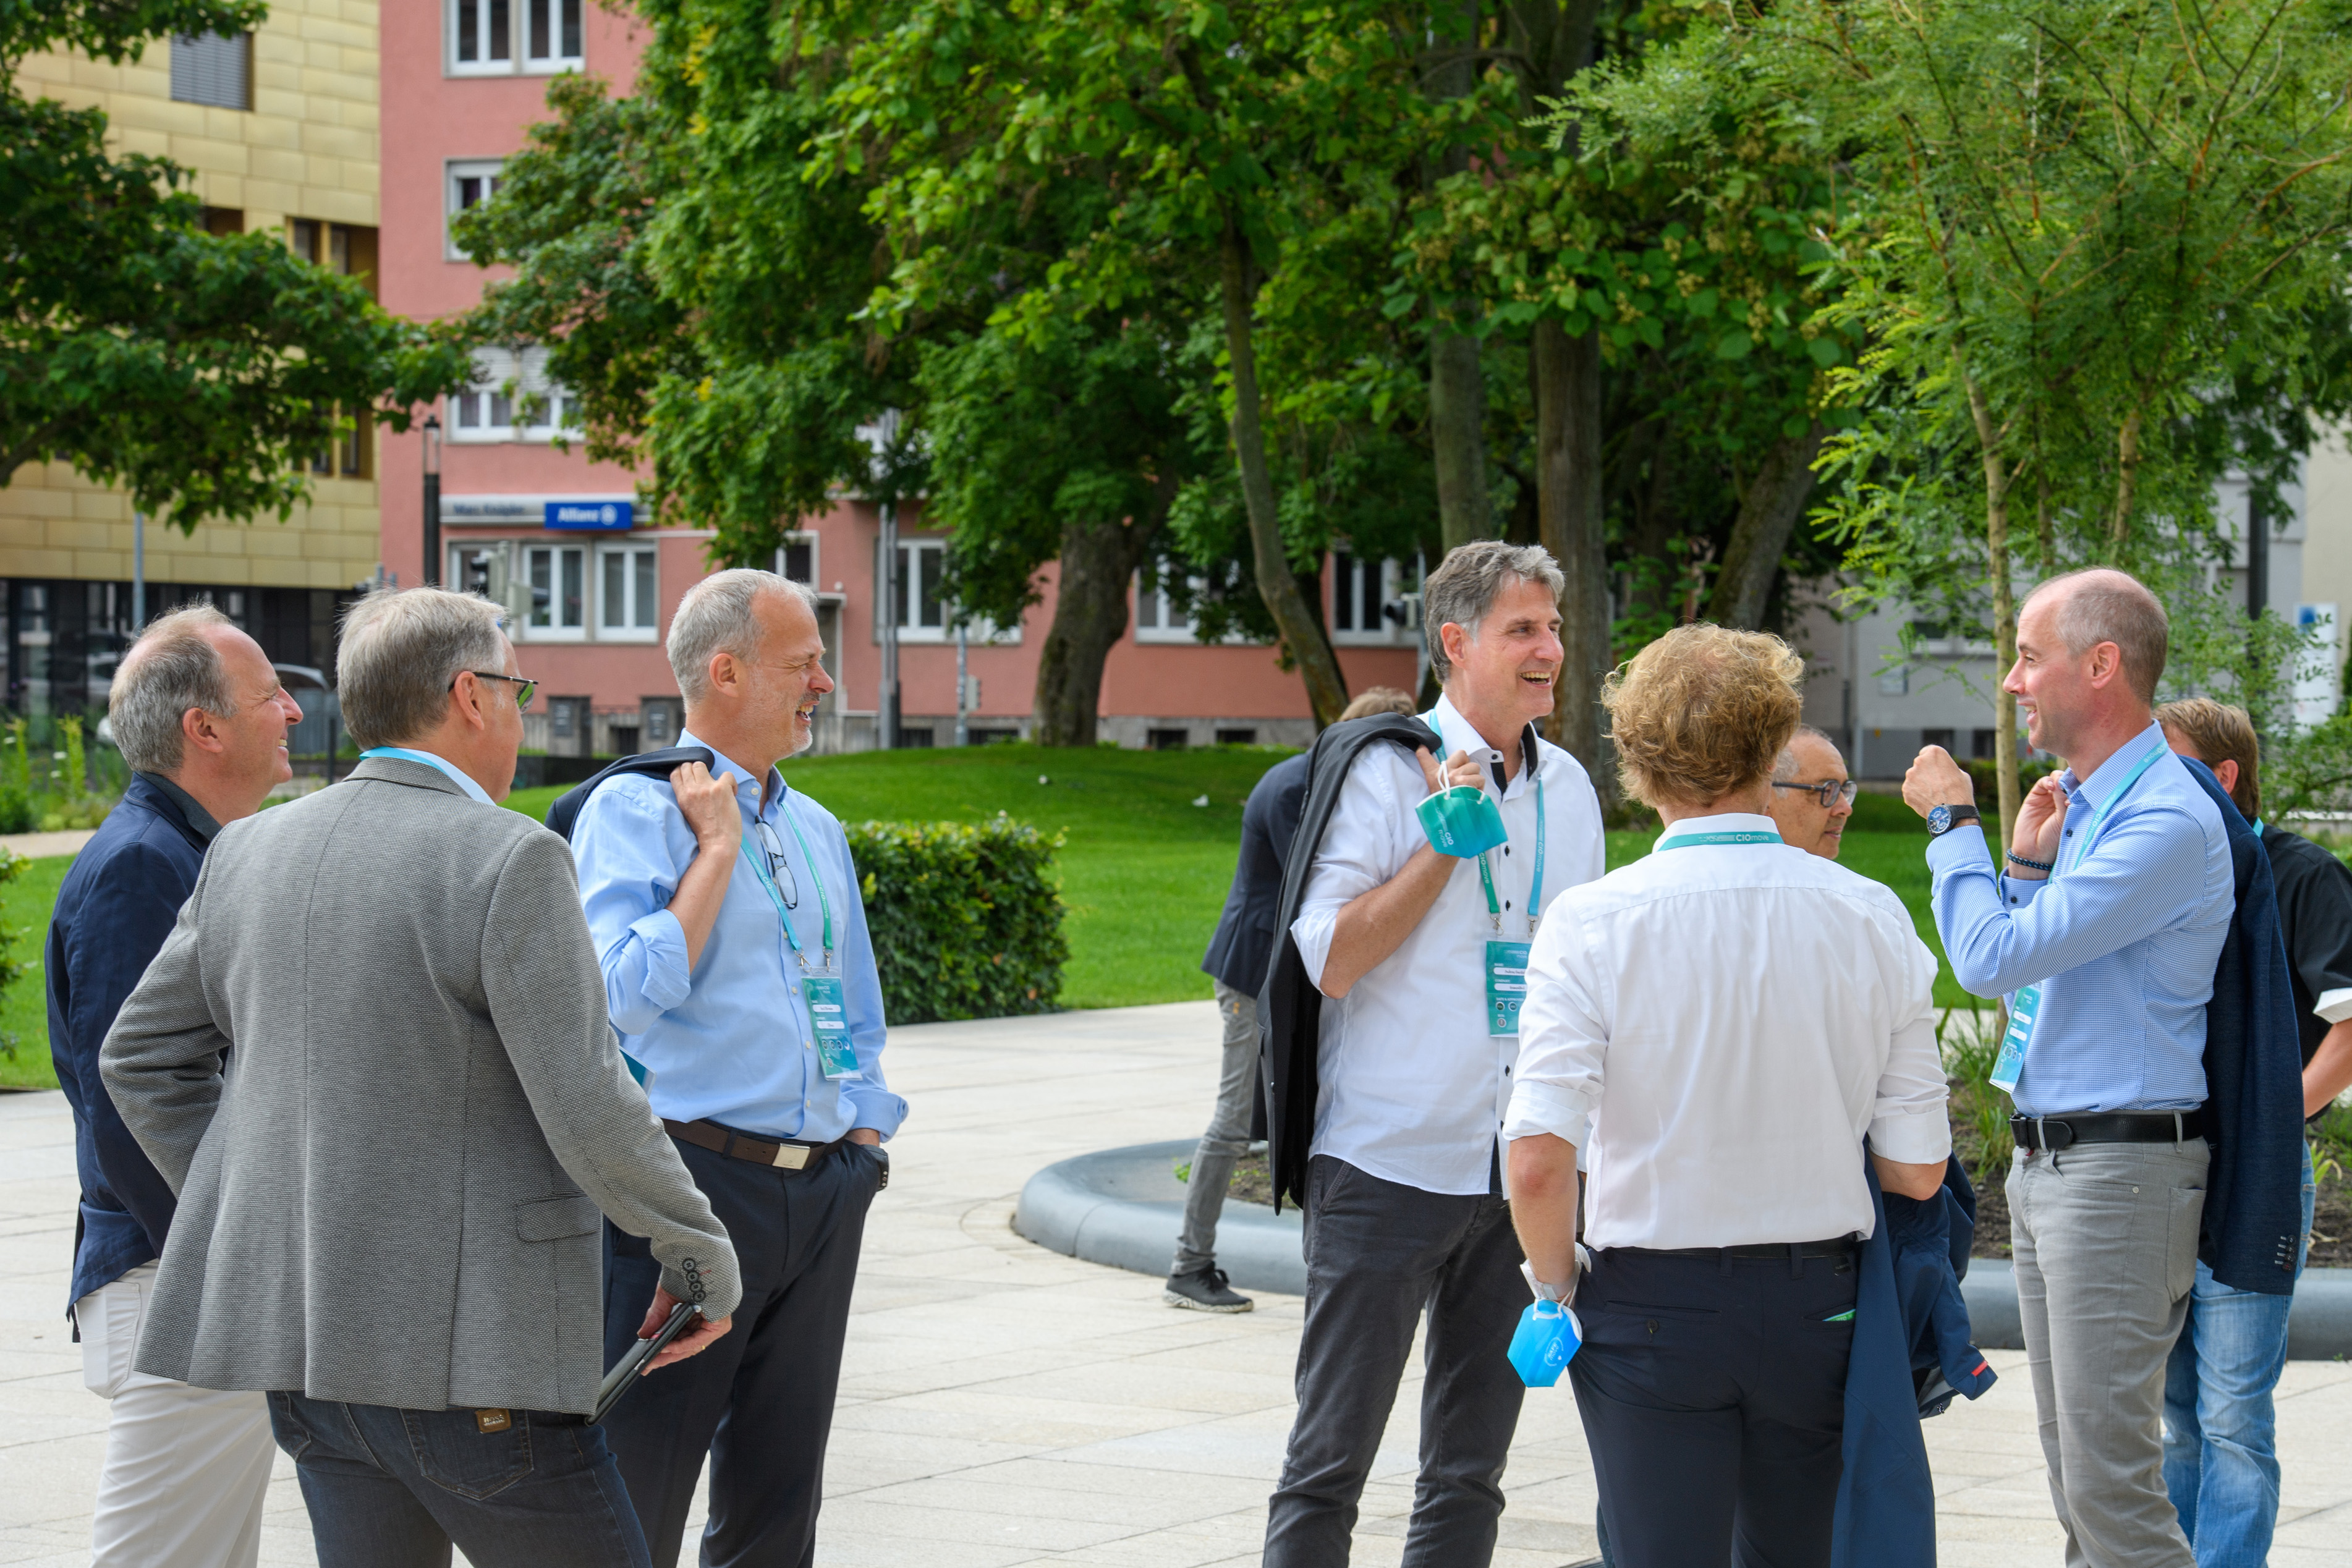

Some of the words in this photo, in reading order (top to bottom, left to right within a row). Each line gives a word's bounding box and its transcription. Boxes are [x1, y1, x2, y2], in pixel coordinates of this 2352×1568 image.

[557, 507, 600, 523] Allianz
[1438, 829, 1448, 847] move
[1445, 832, 1454, 845] CIO
[1736, 834, 1769, 842] CIOmove
[2084, 813, 2102, 845] CIOmove
[1479, 852, 1490, 884] CIOmove
[762, 876, 781, 908] CIOmove
[818, 886, 829, 919] CIOmove
